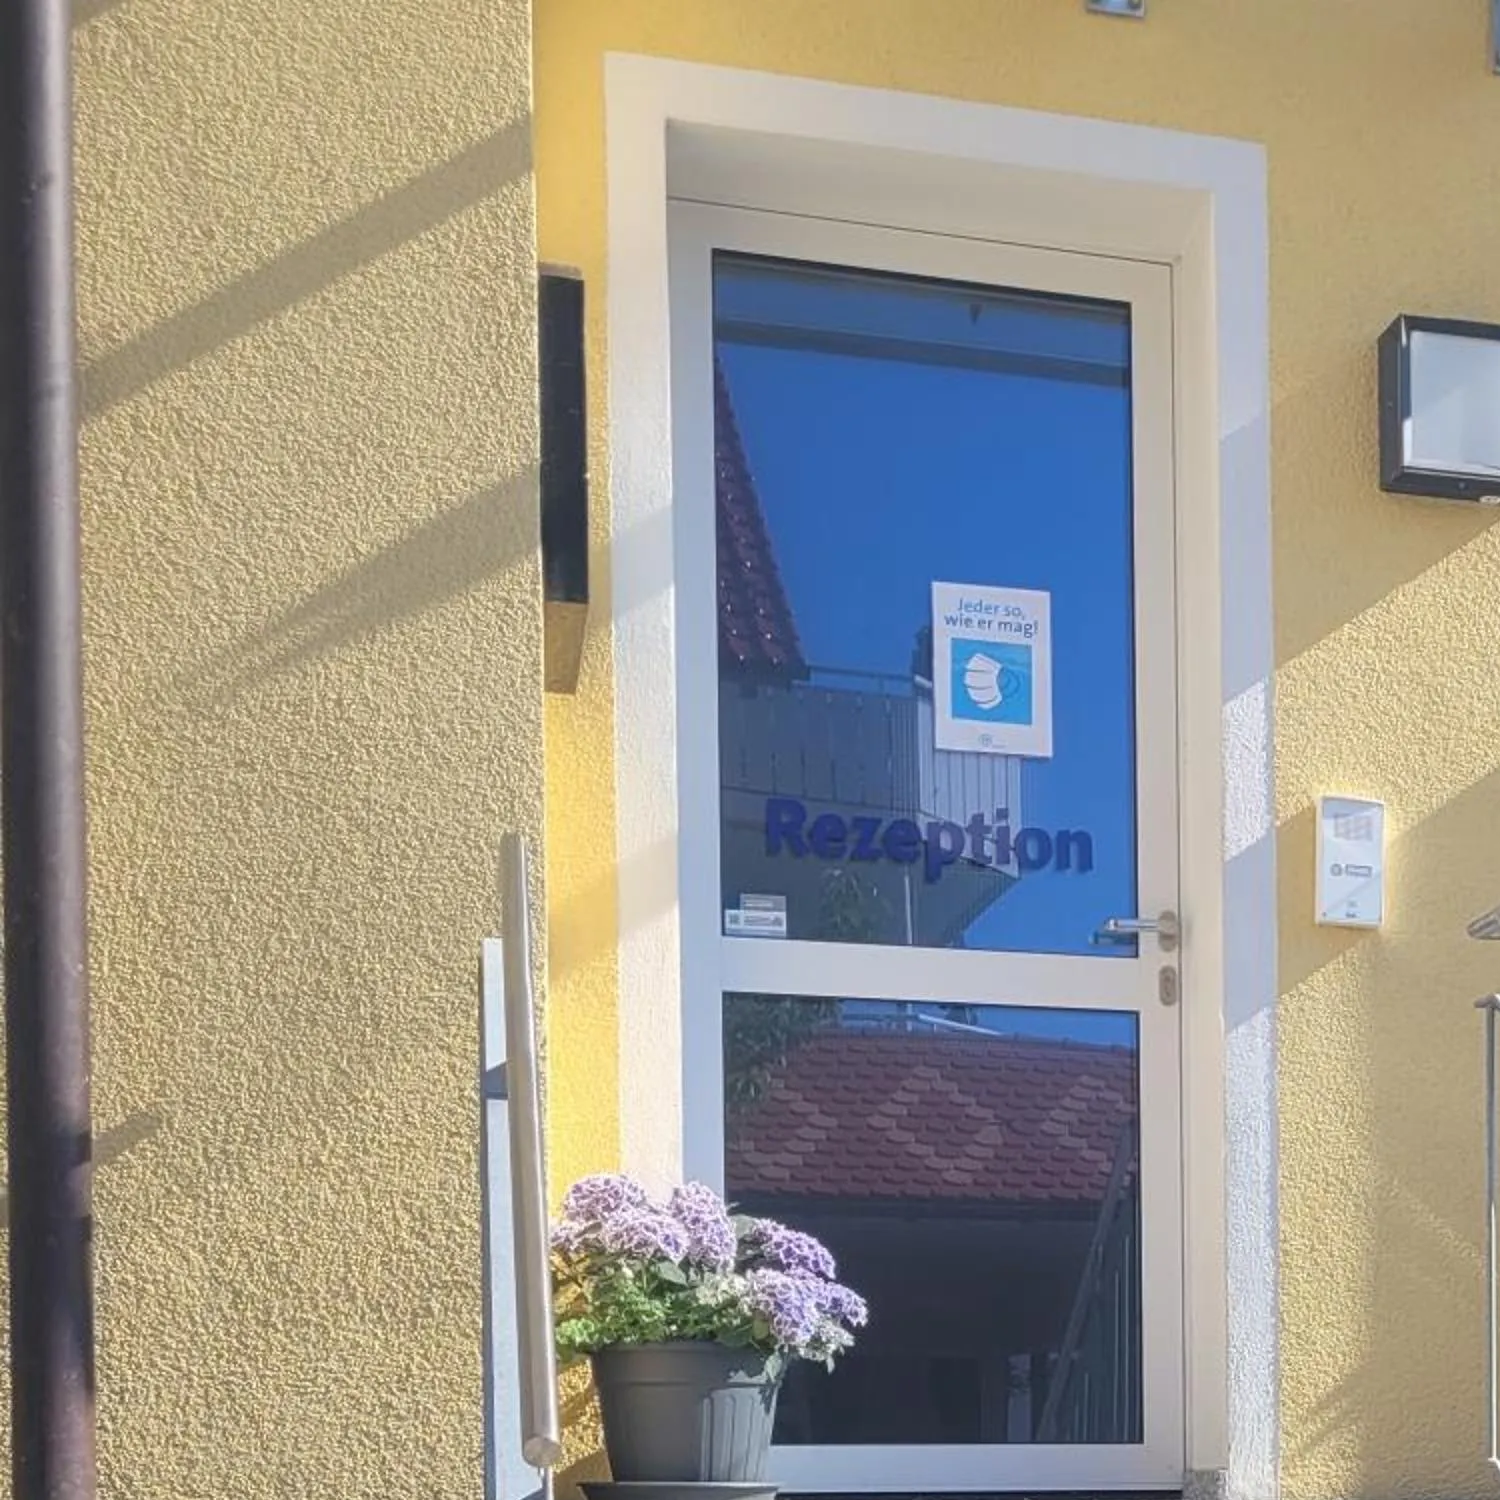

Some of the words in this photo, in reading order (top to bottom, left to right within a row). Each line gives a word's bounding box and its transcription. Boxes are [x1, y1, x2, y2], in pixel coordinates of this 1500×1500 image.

[958, 598, 1000, 615] Jeder
[1002, 606, 1025, 621] so,
[944, 613, 973, 629] wie
[978, 619, 992, 630] er
[998, 619, 1039, 638] mag!
[765, 797, 1094, 884] Rezeption
